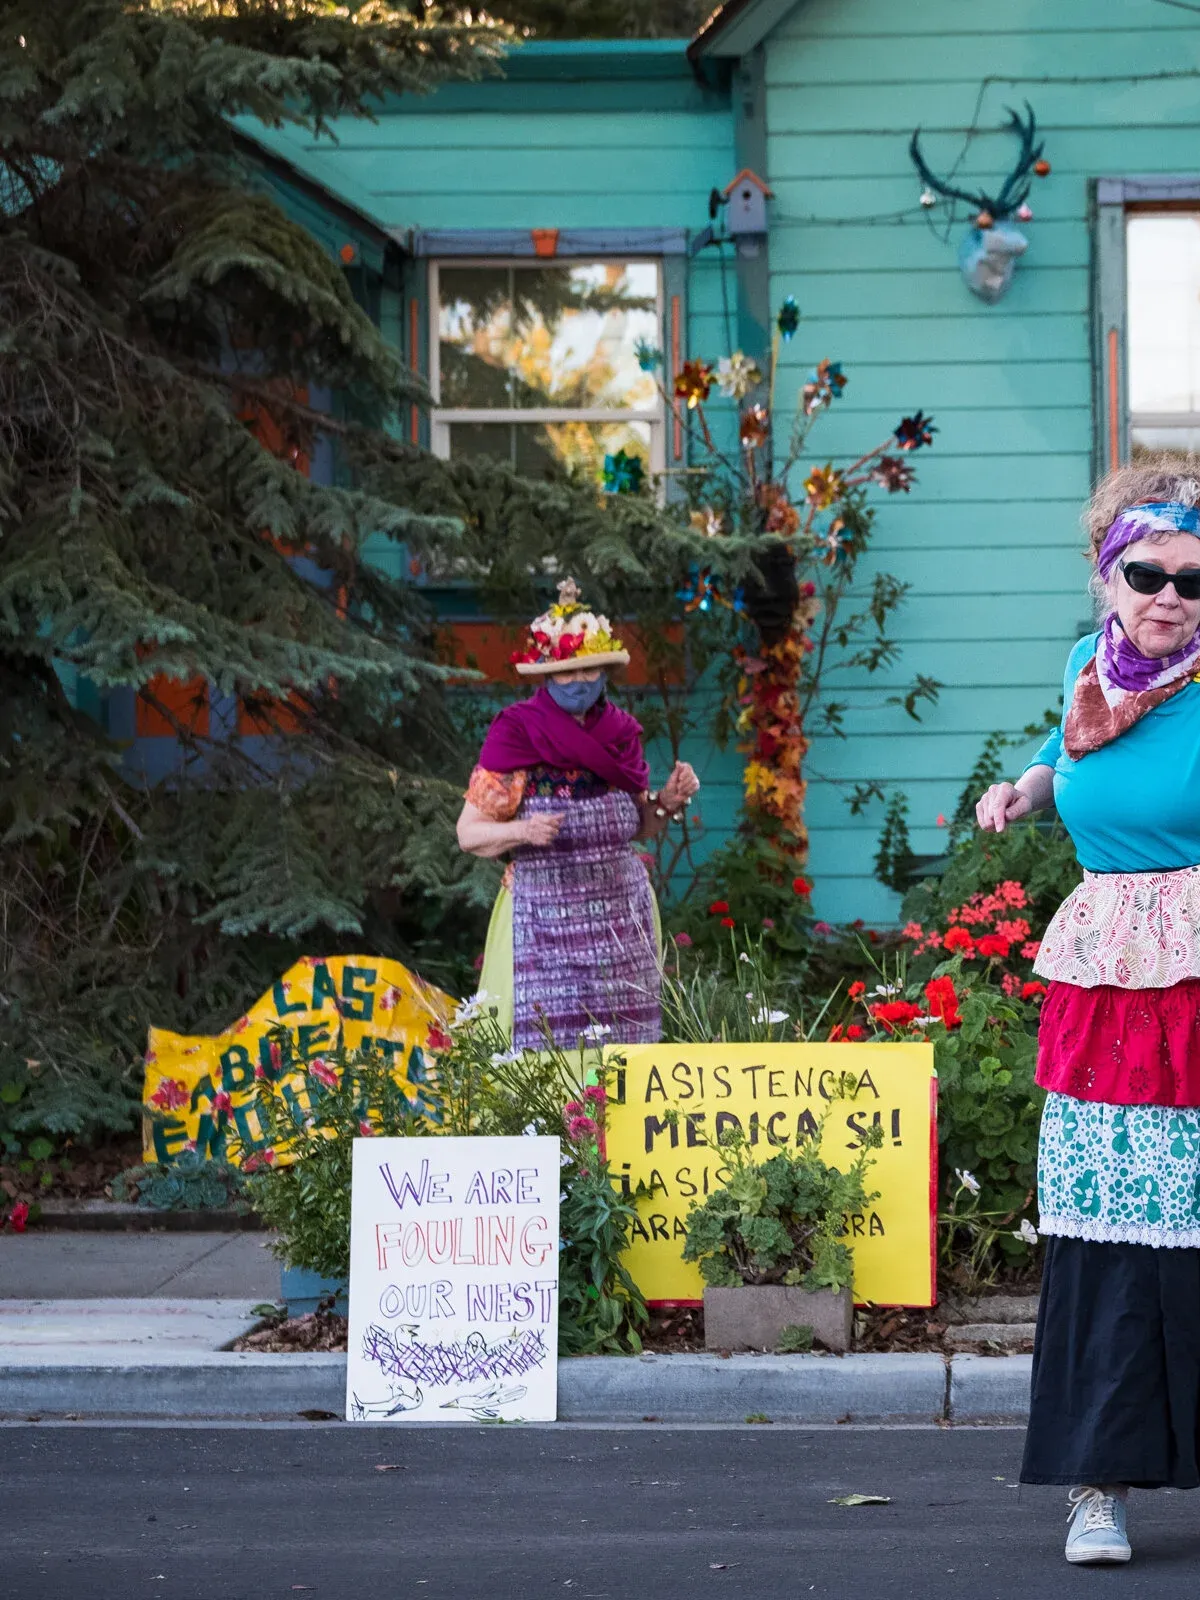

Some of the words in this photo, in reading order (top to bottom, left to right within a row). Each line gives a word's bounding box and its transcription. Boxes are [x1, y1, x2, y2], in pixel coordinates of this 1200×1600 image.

[273, 963, 378, 1022] LAS
[379, 1159, 453, 1210] WE
[465, 1167, 541, 1205] ARE
[375, 1215, 553, 1271] FOULING
[379, 1279, 456, 1320] OUR
[467, 1279, 559, 1324] NEST
